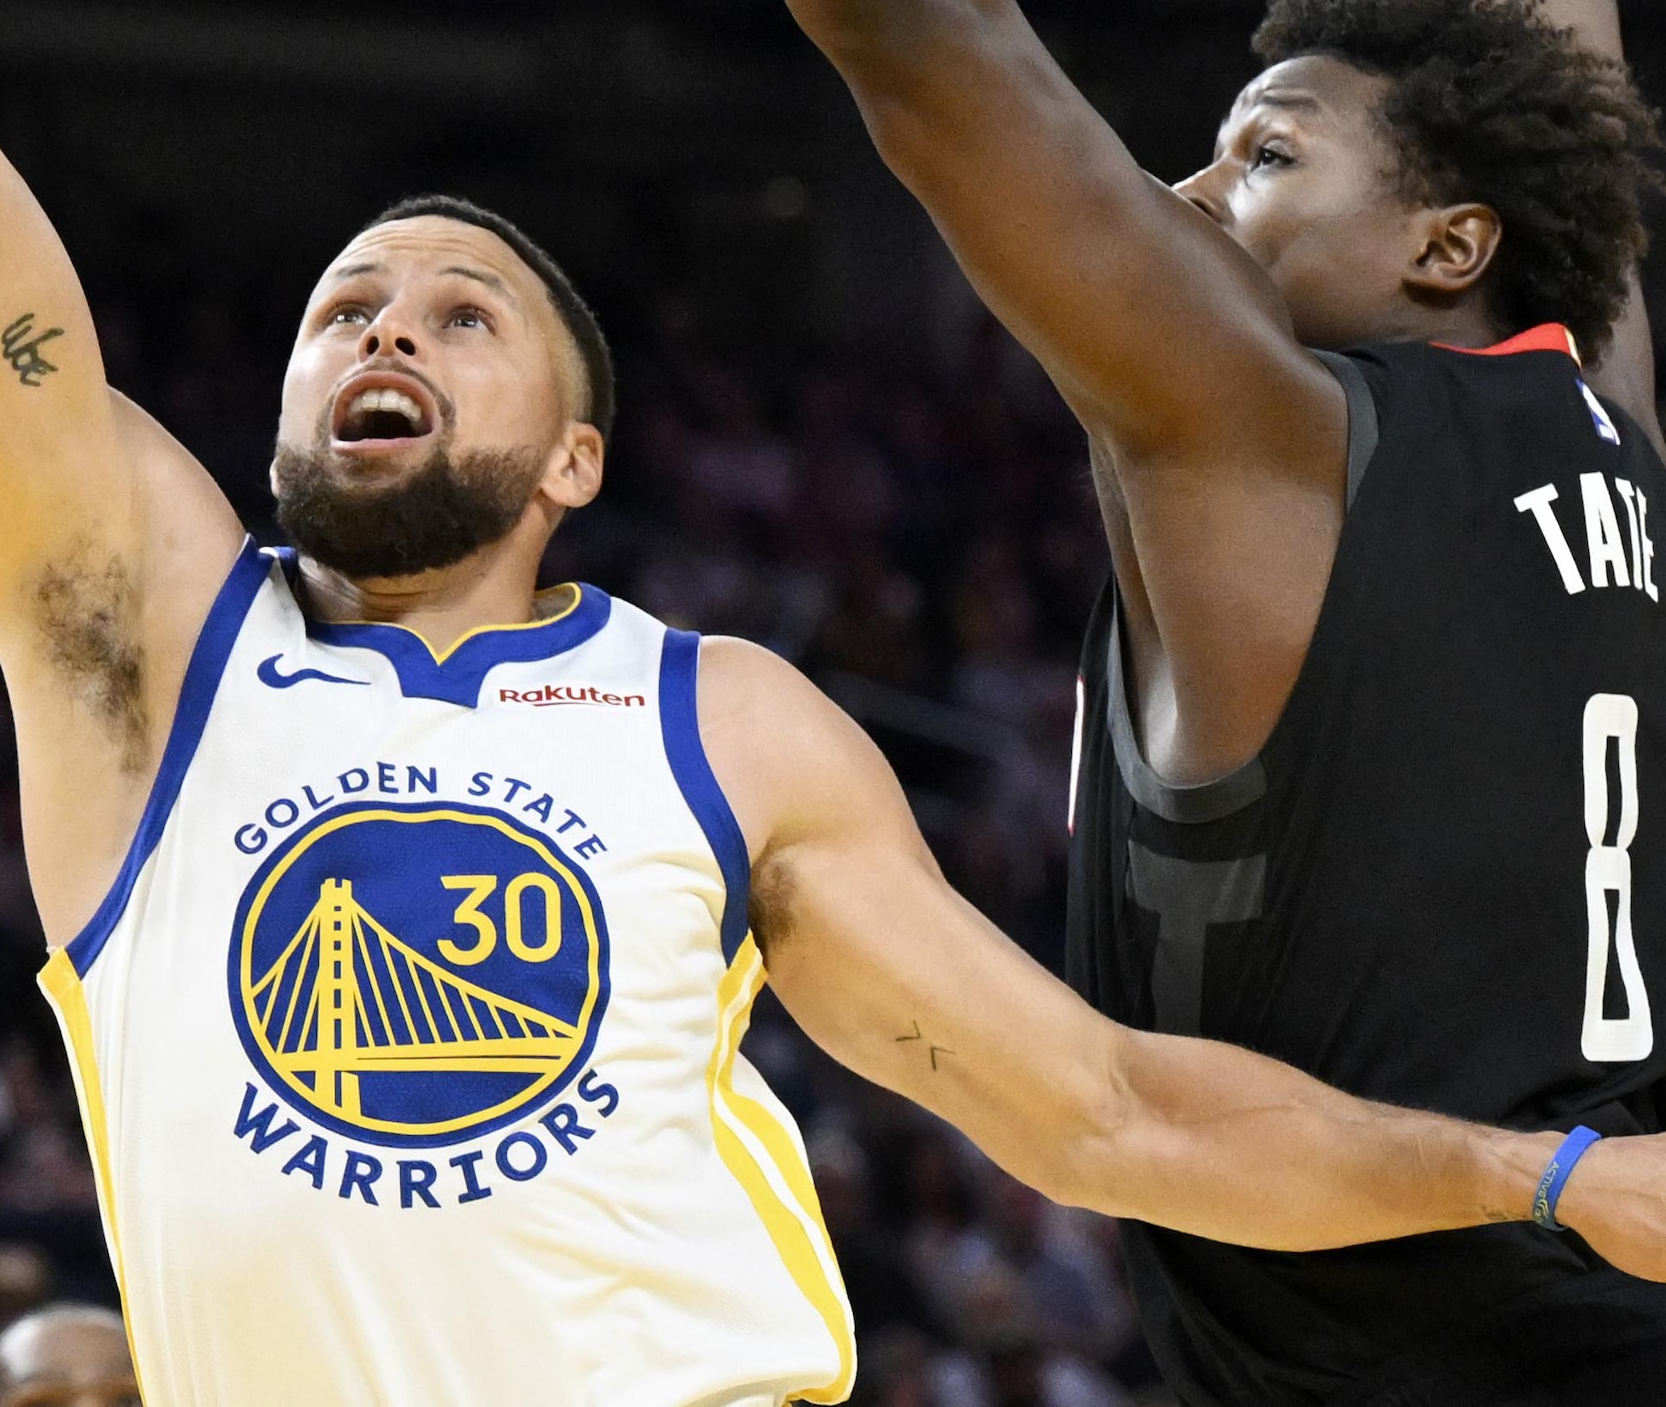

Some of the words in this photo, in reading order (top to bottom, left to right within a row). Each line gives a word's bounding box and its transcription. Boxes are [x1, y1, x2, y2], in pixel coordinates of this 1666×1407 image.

[1513, 471, 1659, 603] TATE
[499, 685, 645, 708] Rakuten
[236, 761, 438, 857] GOLDEN
[467, 771, 608, 862] STATE
[437, 871, 562, 966] 30
[1580, 692, 1653, 1063] 8
[233, 1069, 620, 1210] WARRIORS
